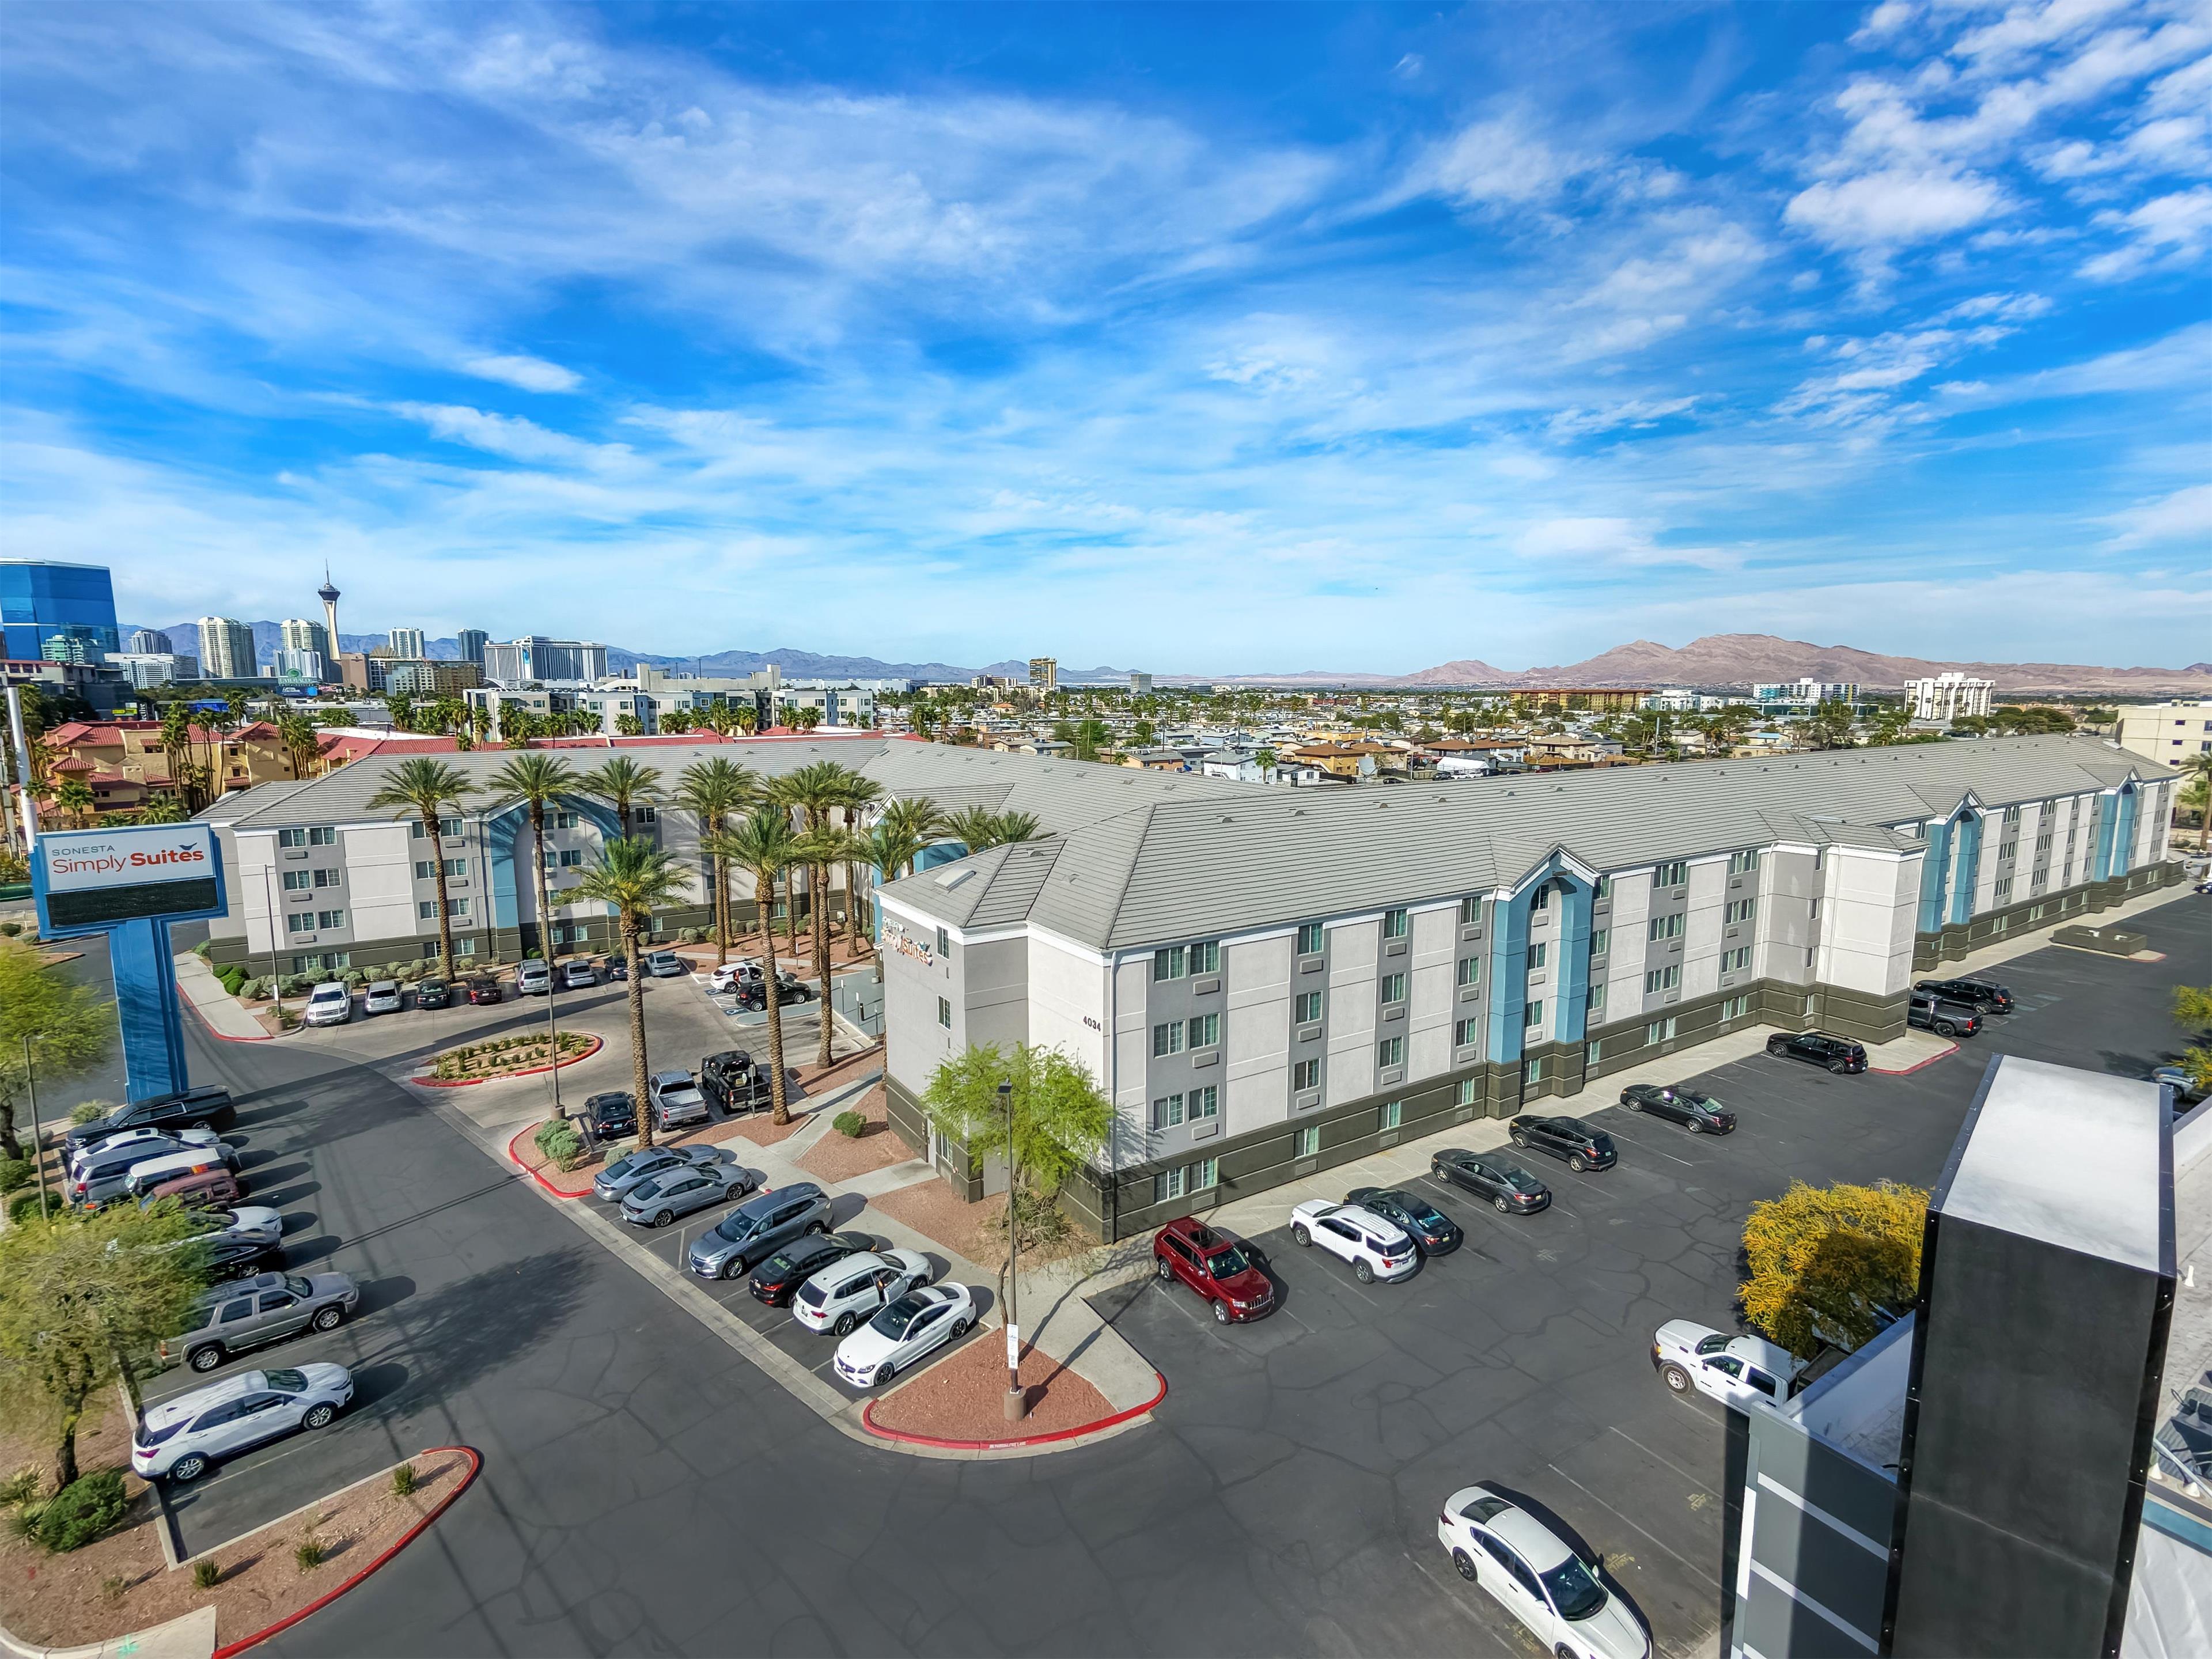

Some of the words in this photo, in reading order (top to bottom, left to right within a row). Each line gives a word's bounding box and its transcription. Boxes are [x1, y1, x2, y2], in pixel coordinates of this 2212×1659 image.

[52, 845, 115, 856] SONESTA
[53, 855, 126, 873] Simply
[130, 849, 204, 866] Suites
[1083, 1016, 1101, 1032] 4034
